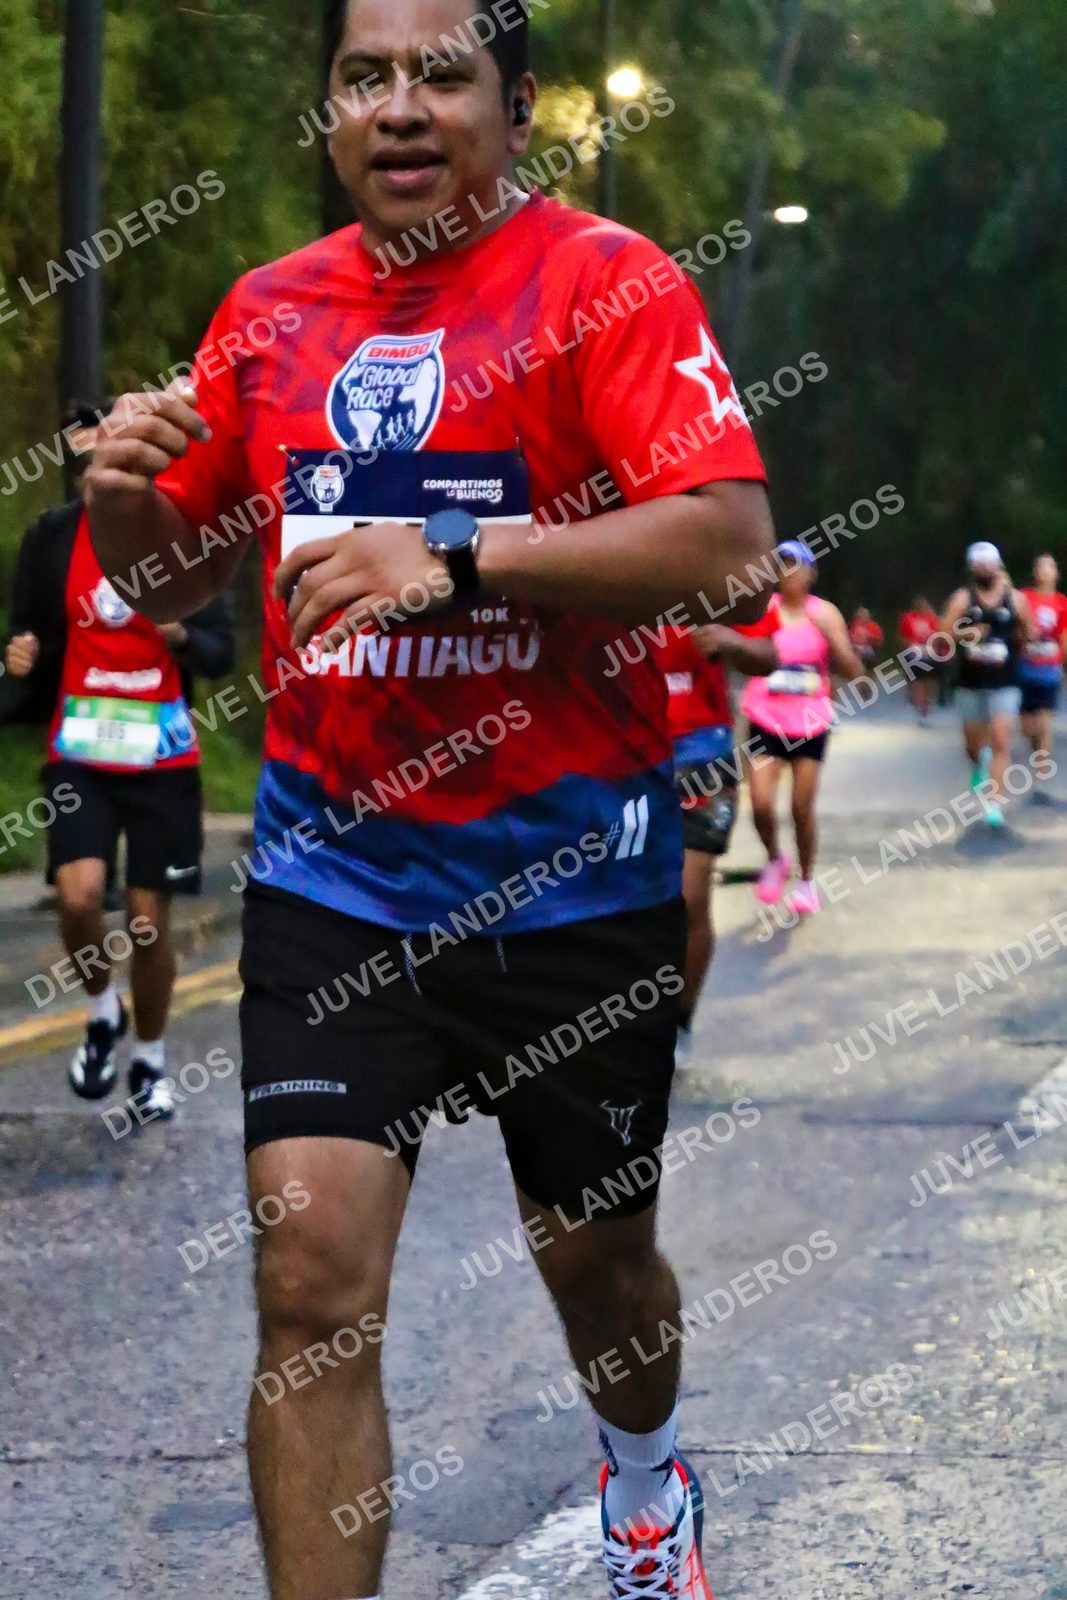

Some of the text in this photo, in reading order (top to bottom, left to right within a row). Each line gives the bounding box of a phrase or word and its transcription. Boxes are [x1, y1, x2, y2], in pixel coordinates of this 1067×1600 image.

[368, 342, 431, 358] BIMBO
[361, 361, 422, 388] Global
[346, 386, 394, 410] Race
[423, 479, 502, 489] COMPARTIMOS
[470, 607, 509, 623] 10K
